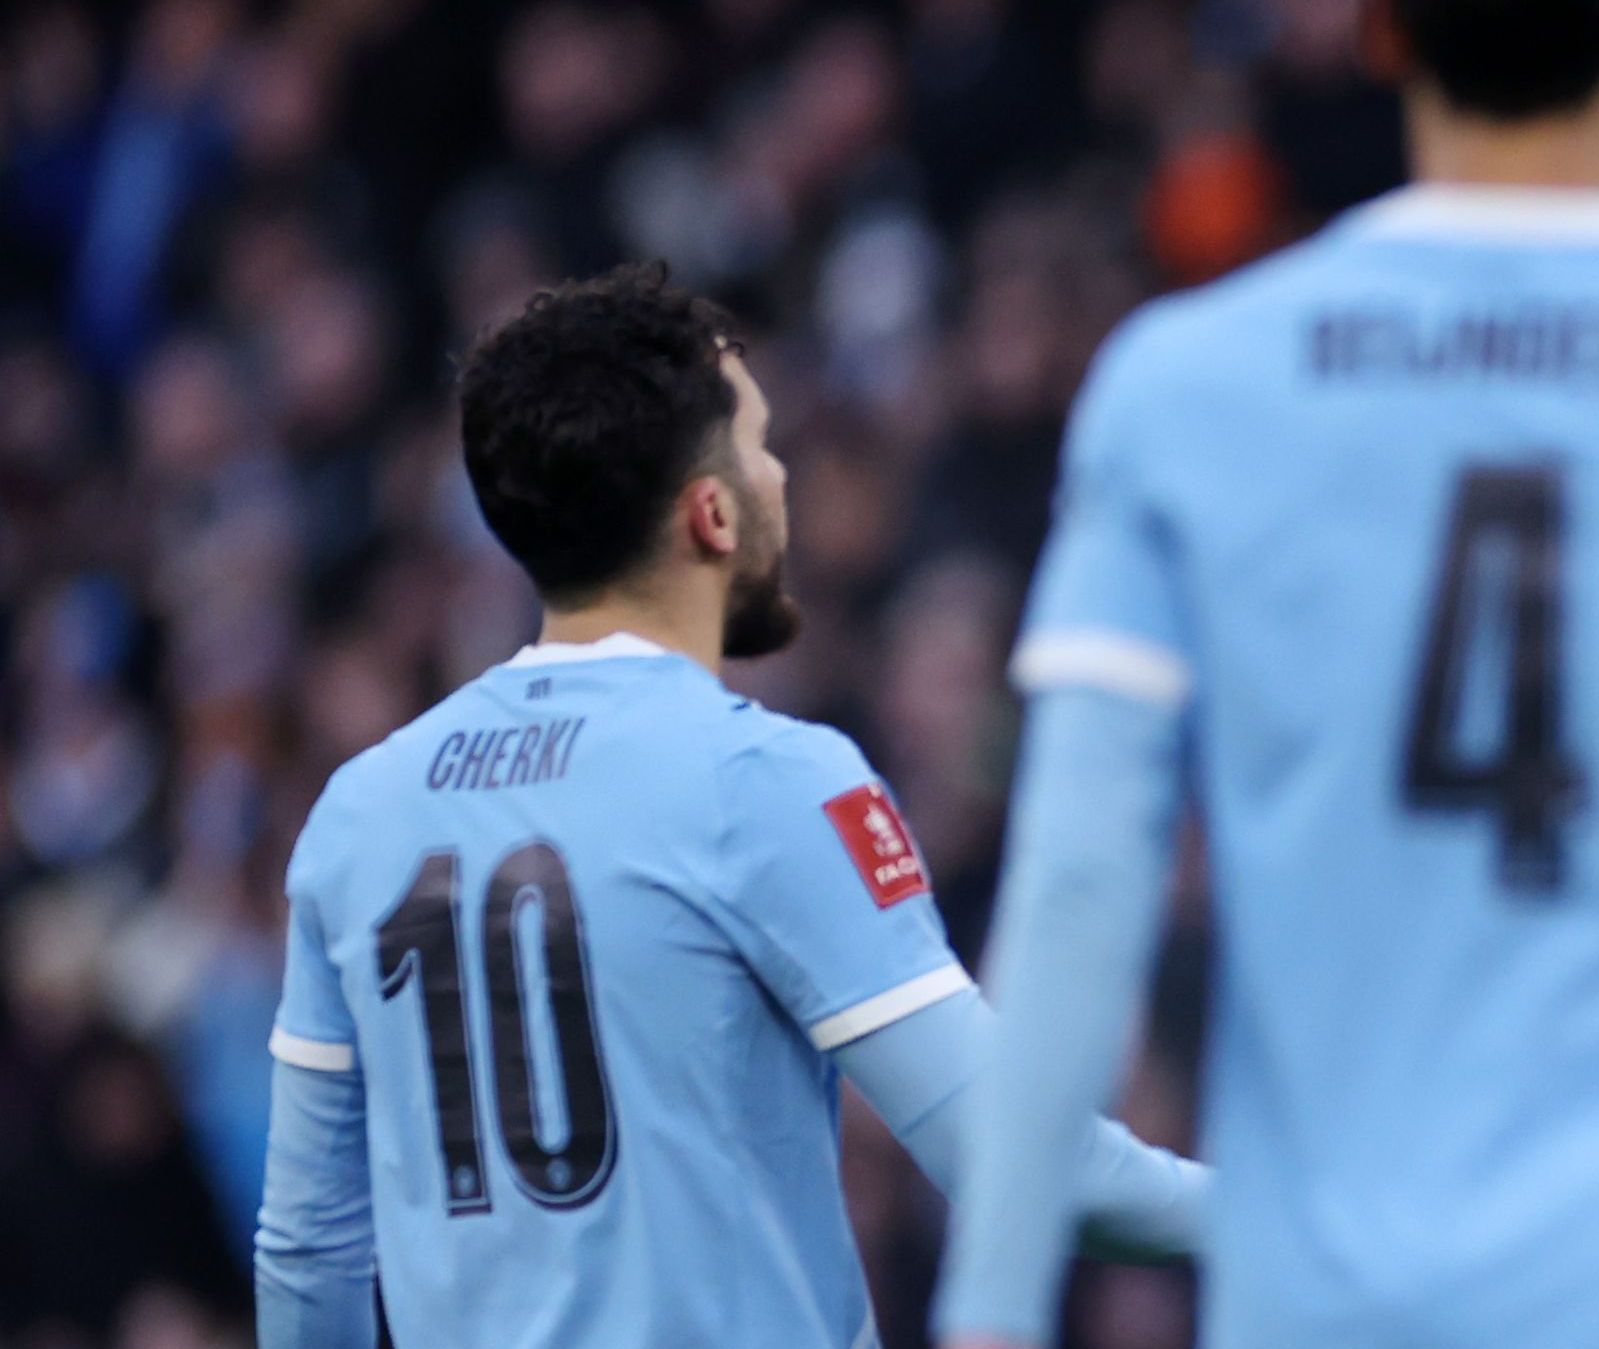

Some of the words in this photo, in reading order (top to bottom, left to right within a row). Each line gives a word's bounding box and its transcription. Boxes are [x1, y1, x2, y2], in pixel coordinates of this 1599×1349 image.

[426, 716, 586, 792] CHERKI
[1399, 452, 1592, 900] 4
[376, 836, 619, 1218] 10
